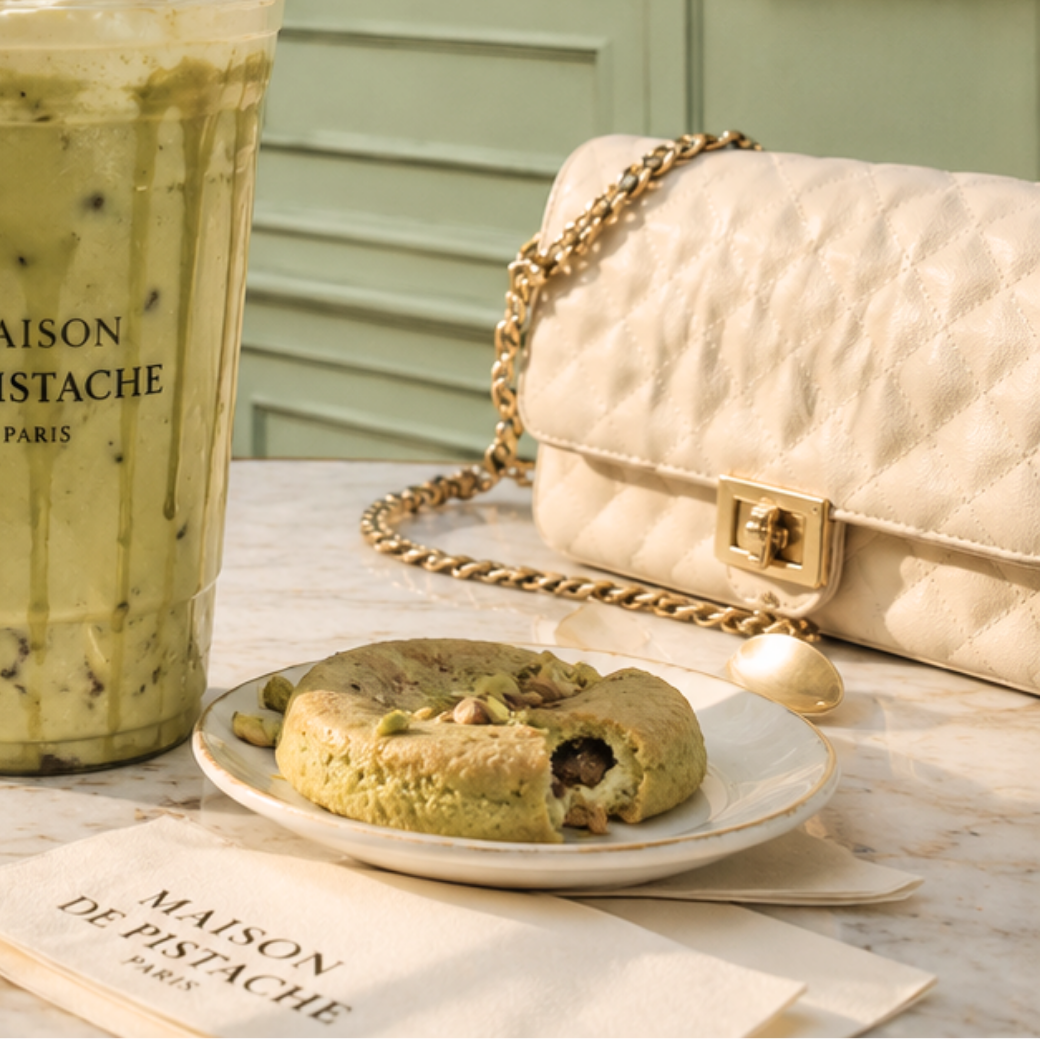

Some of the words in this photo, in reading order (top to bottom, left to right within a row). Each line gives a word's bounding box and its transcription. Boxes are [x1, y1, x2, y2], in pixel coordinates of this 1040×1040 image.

[3, 426, 71, 444] PARIS
[57, 895, 127, 929] DE
[119, 922, 352, 1026] PISTACHE
[139, 890, 344, 977] MAISON
[122, 954, 200, 992] PARIS
